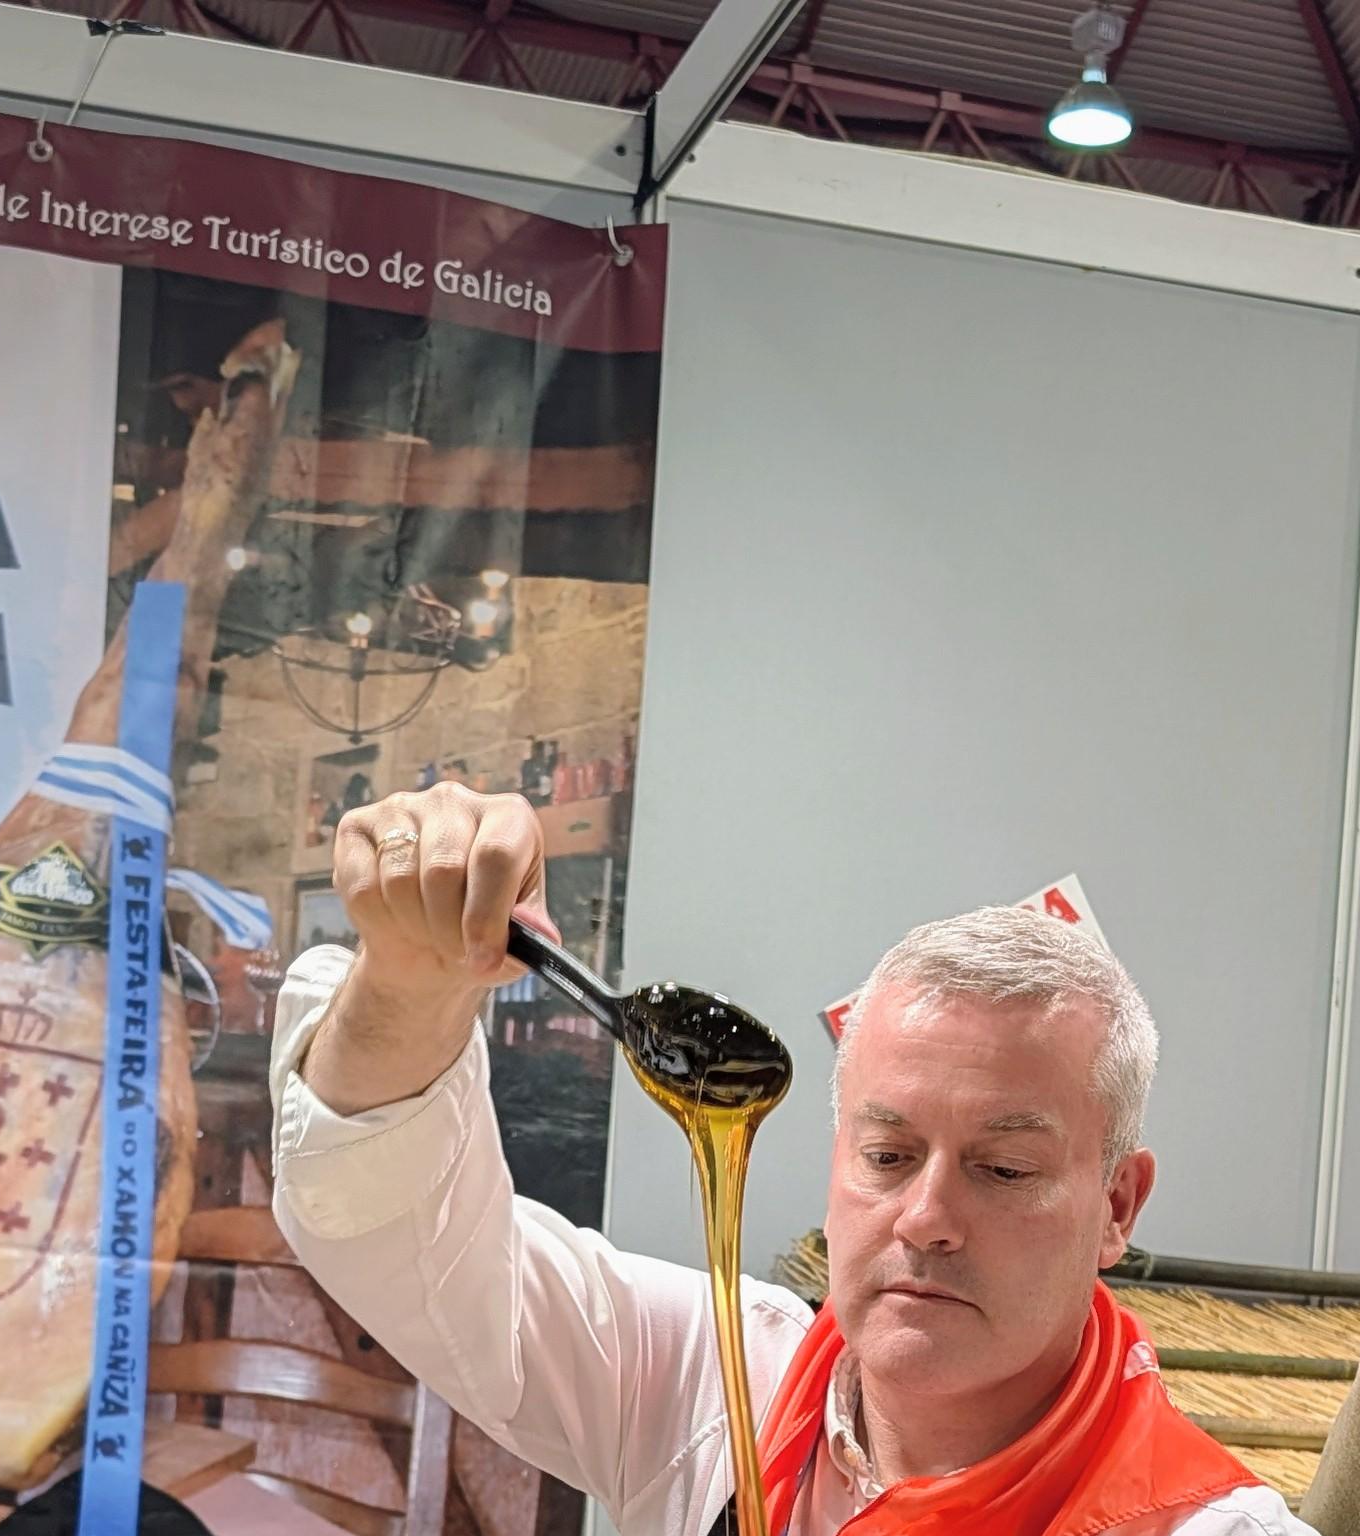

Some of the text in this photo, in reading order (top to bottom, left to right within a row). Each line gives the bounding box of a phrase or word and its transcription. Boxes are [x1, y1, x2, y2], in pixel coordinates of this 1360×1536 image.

[40, 190, 194, 246] Interese
[202, 216, 371, 278] Turístico
[380, 251, 427, 288] de
[434, 259, 554, 317] Galicia
[117, 874, 152, 1112] FESTA-FEIRA
